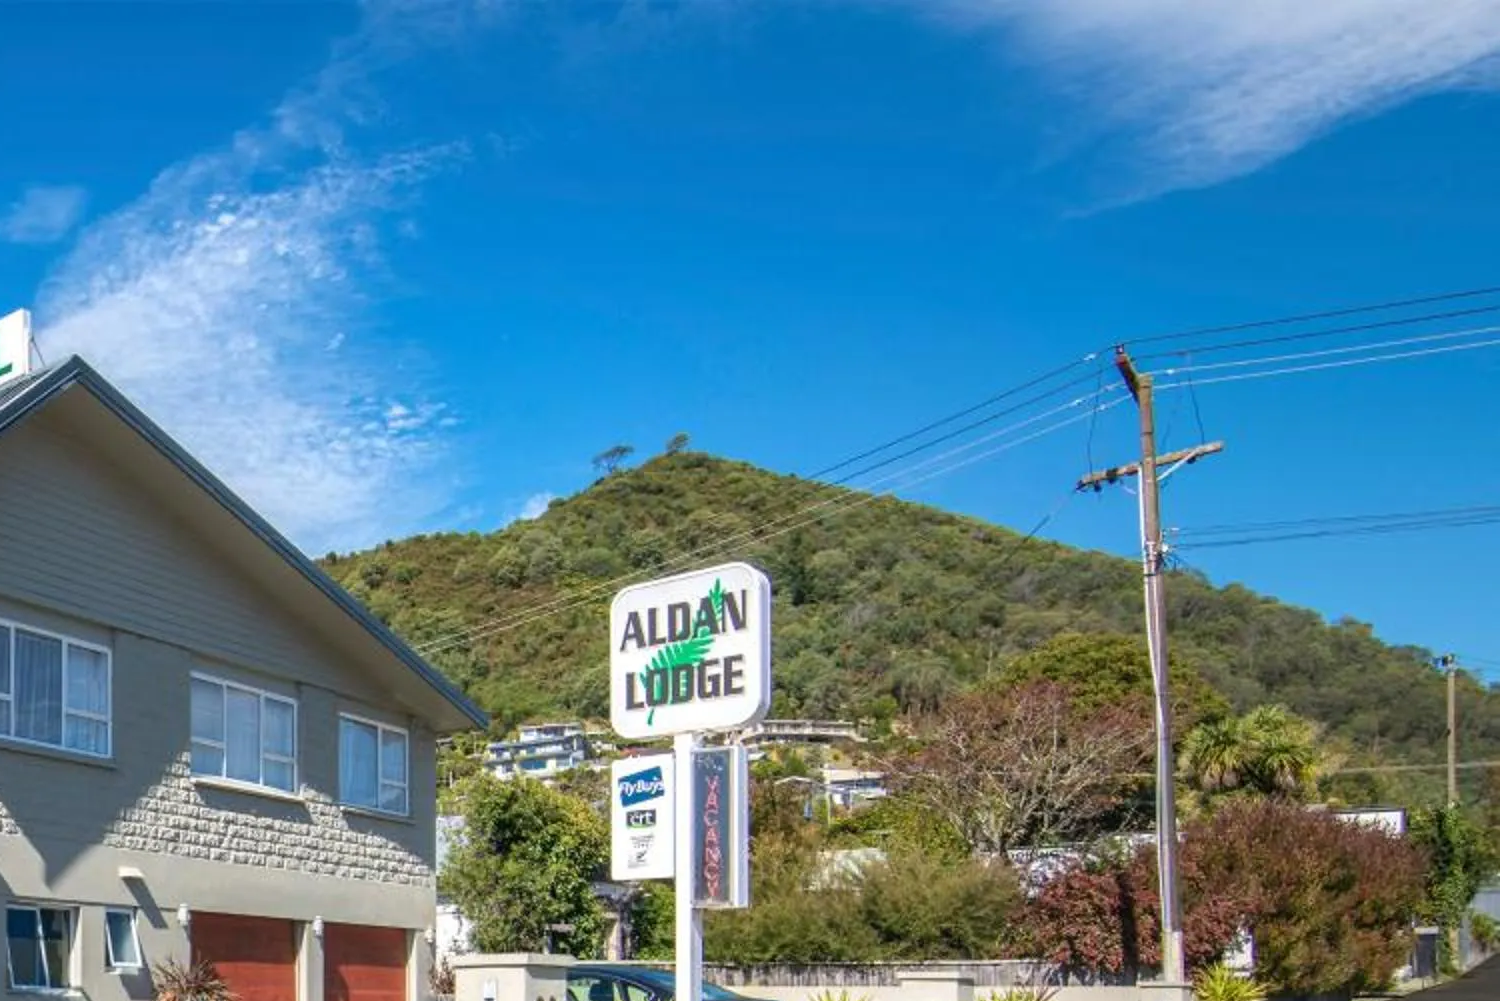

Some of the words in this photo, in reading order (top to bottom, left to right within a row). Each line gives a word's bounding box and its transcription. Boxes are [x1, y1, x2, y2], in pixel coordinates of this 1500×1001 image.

[619, 589, 747, 652] ALDAN
[625, 654, 744, 710] LODGE
[703, 774, 720, 897] VACANCY
